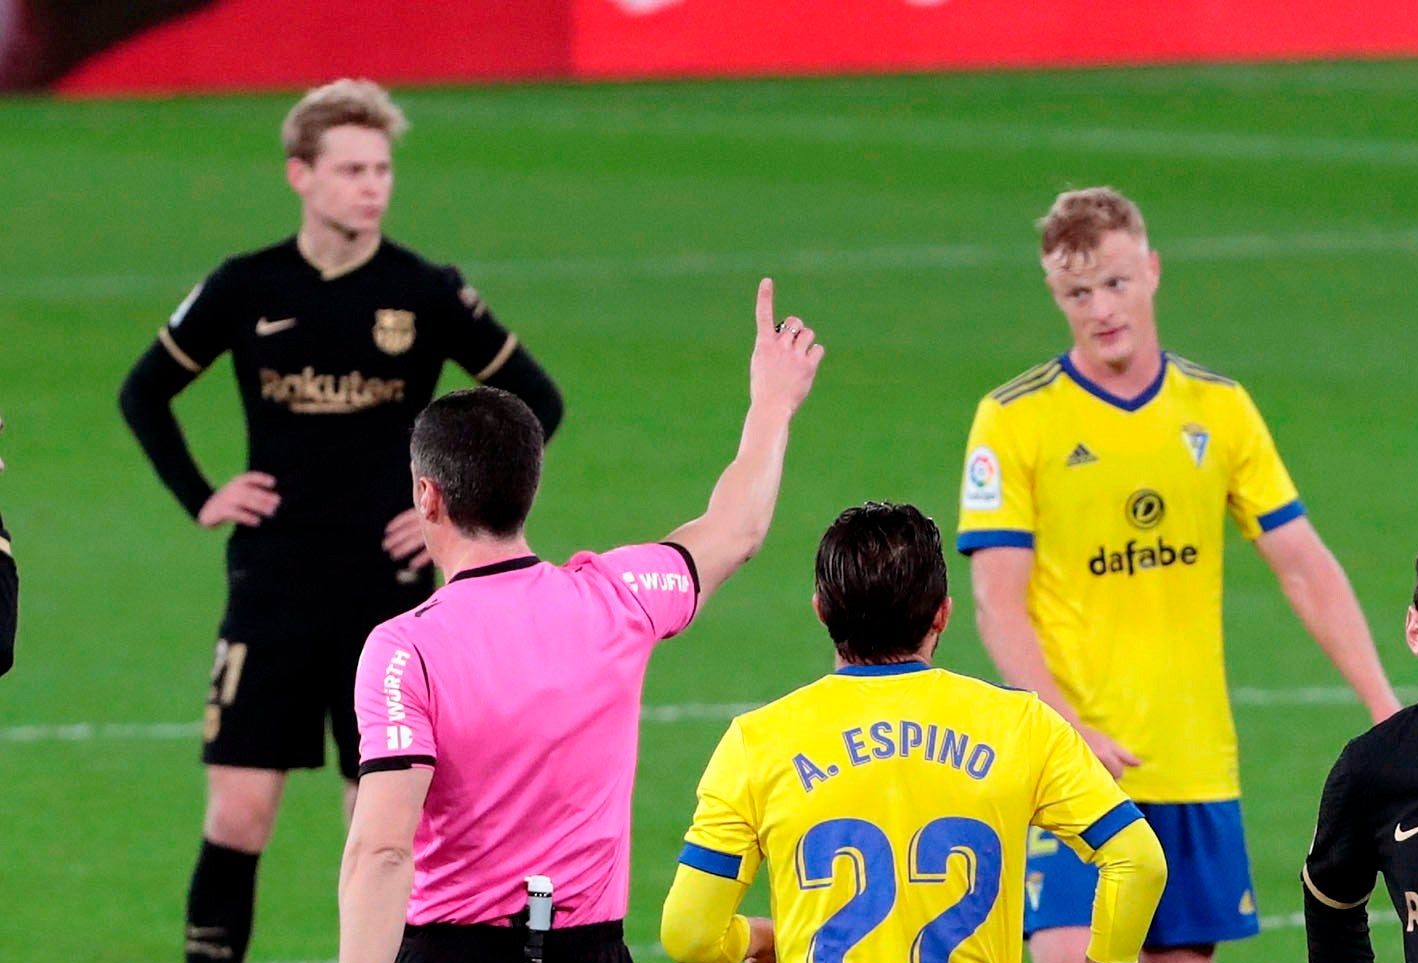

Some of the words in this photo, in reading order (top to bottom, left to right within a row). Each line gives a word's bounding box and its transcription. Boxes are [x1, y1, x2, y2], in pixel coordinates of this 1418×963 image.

[259, 366, 406, 404] Rakuten
[792, 753, 840, 793] A.
[842, 720, 996, 780] ESPINO
